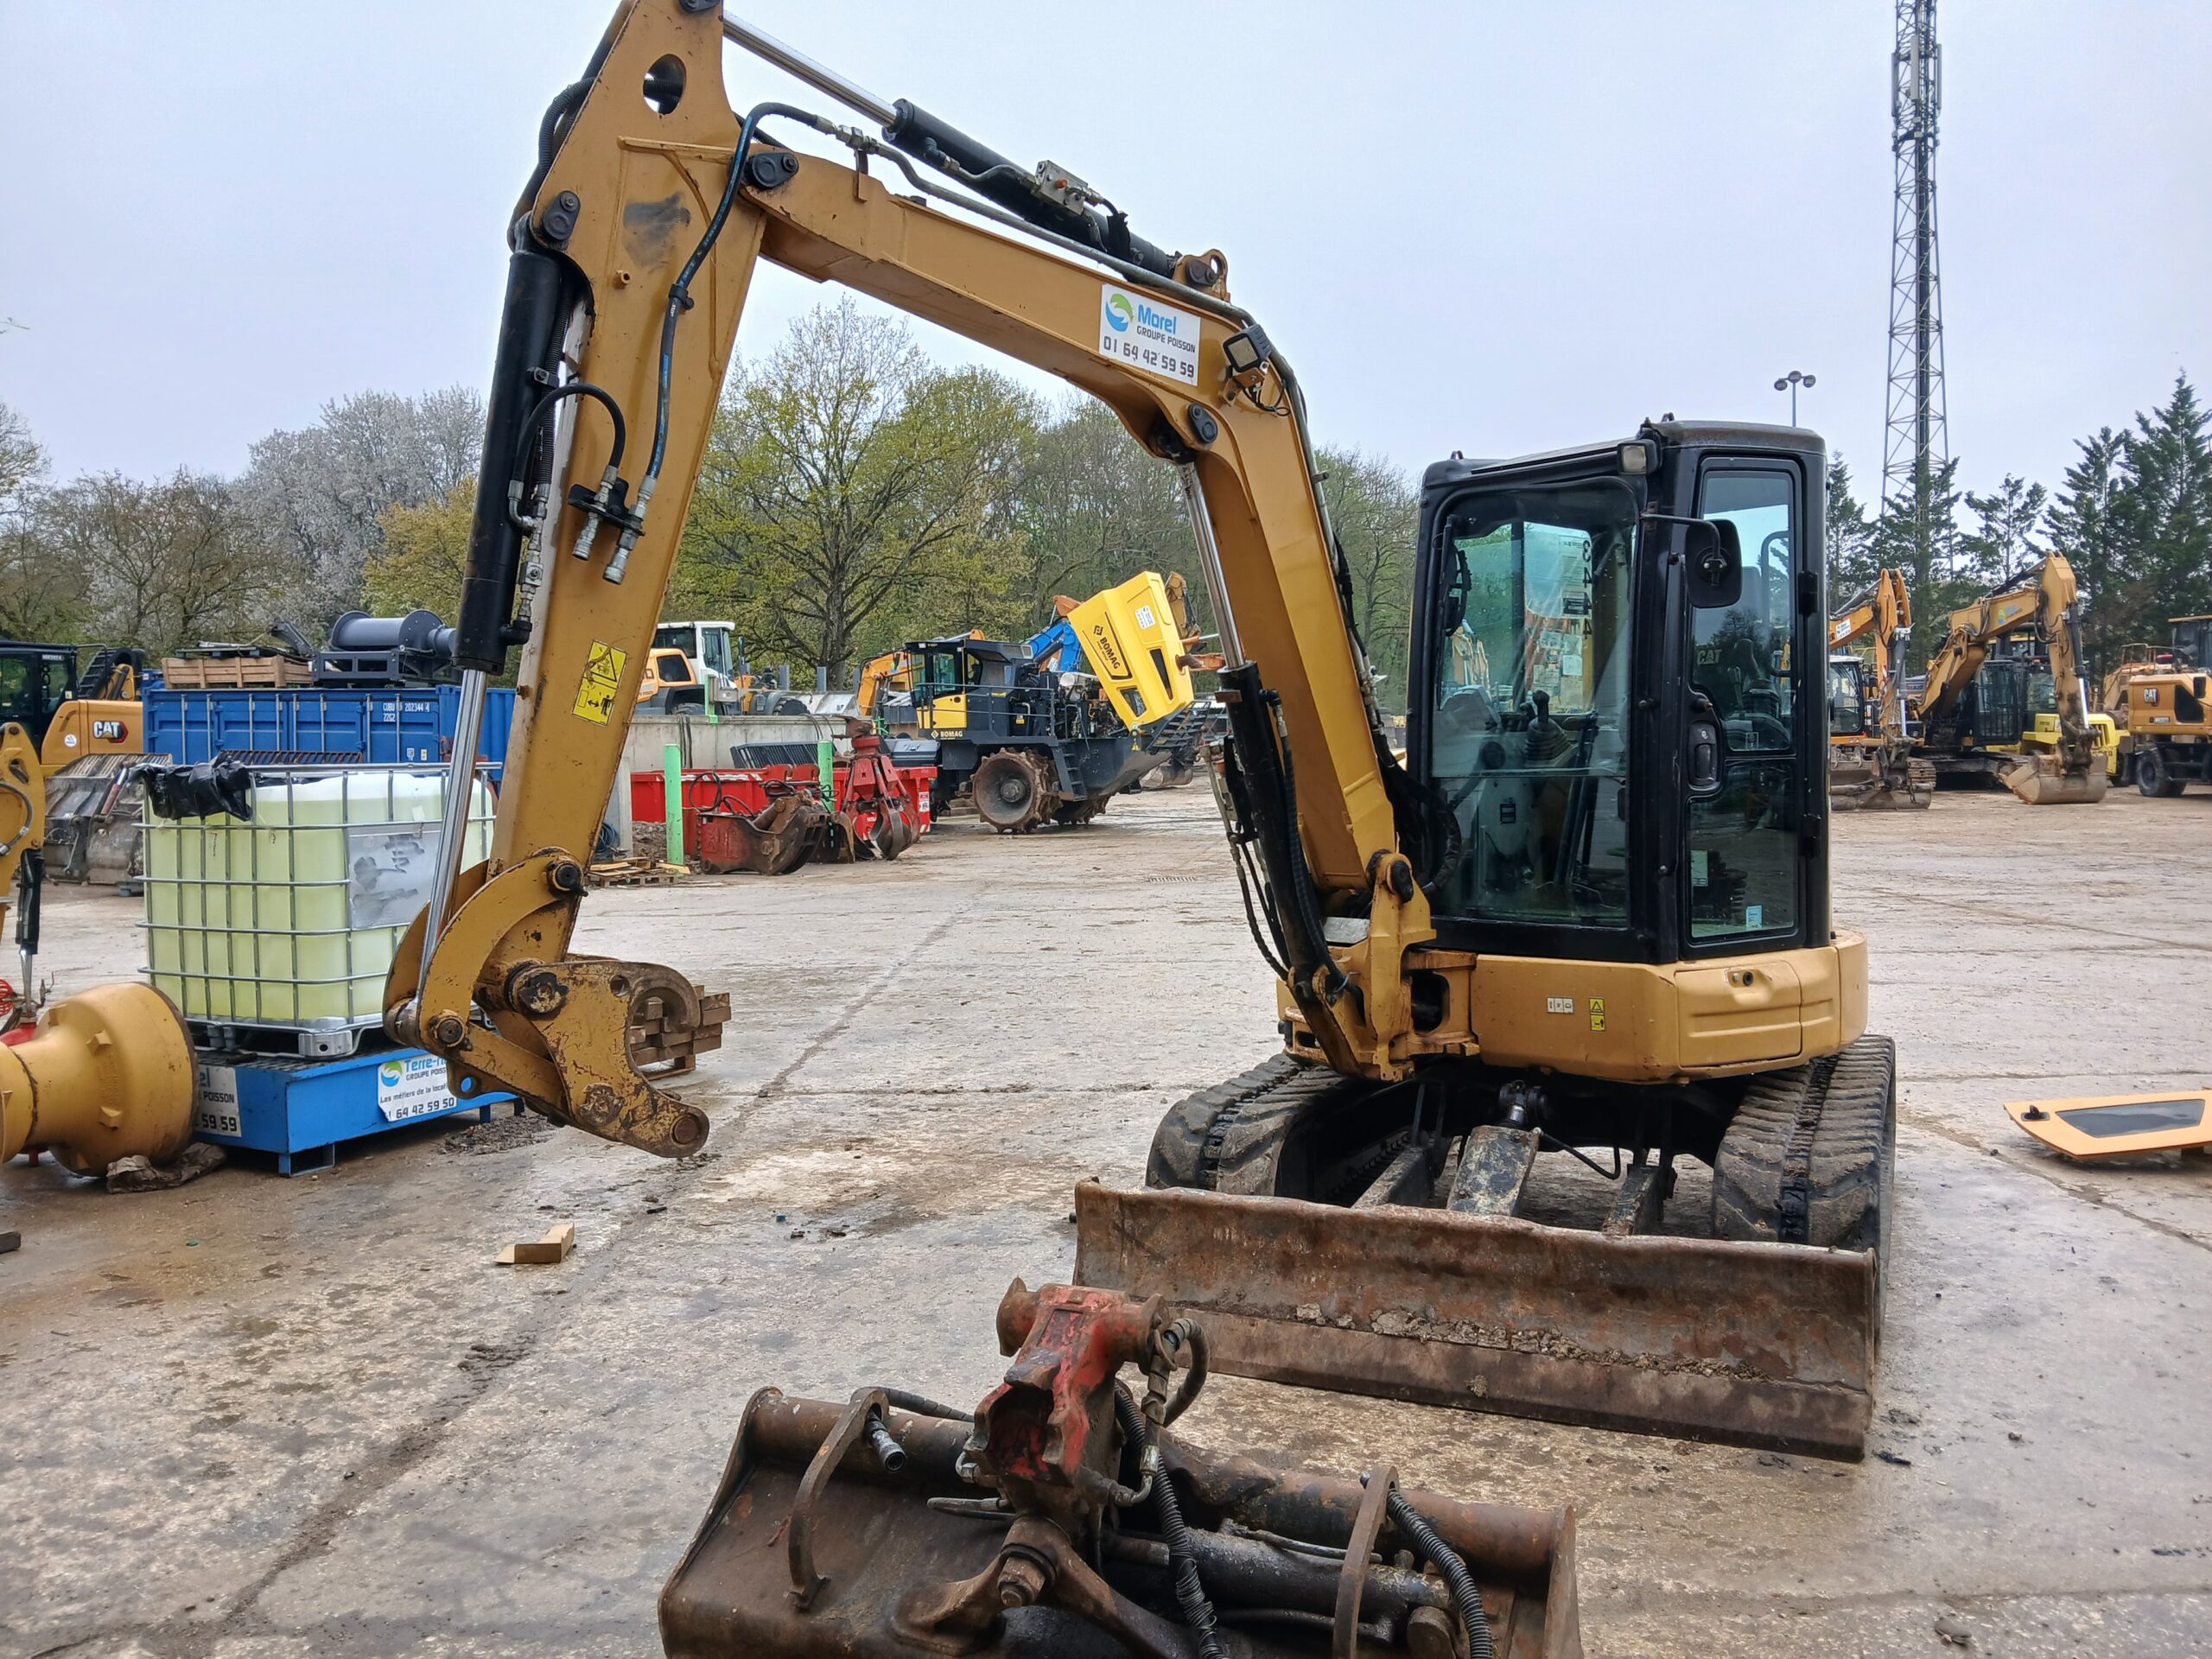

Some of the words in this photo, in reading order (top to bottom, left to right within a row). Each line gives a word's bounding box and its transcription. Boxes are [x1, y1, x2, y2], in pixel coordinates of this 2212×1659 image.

[1137, 303, 1177, 335] Morel
[1136, 325, 1166, 344] GROUPE
[1166, 335, 1196, 353] POISSON
[1103, 335, 1117, 353] 01
[1122, 342, 1139, 359] 64
[1142, 348, 1158, 366] 42
[1160, 354, 1177, 372] 59
[1179, 361, 1194, 378] 59
[1100, 637, 1121, 669] BOMAG
[1697, 649, 1722, 665] CAT
[2144, 688, 2158, 702] CAT
[93, 721, 119, 739] CAT
[405, 1070, 429, 1081] GROUPE
[430, 1066, 447, 1076] POISS
[203, 1091, 234, 1103] POISSON
[396, 1107, 409, 1119] 64
[411, 1103, 424, 1115] 42
[427, 1100, 440, 1112] 59
[442, 1096, 454, 1109] 50
[201, 1113, 217, 1129] 59
[220, 1116, 238, 1132] 59
